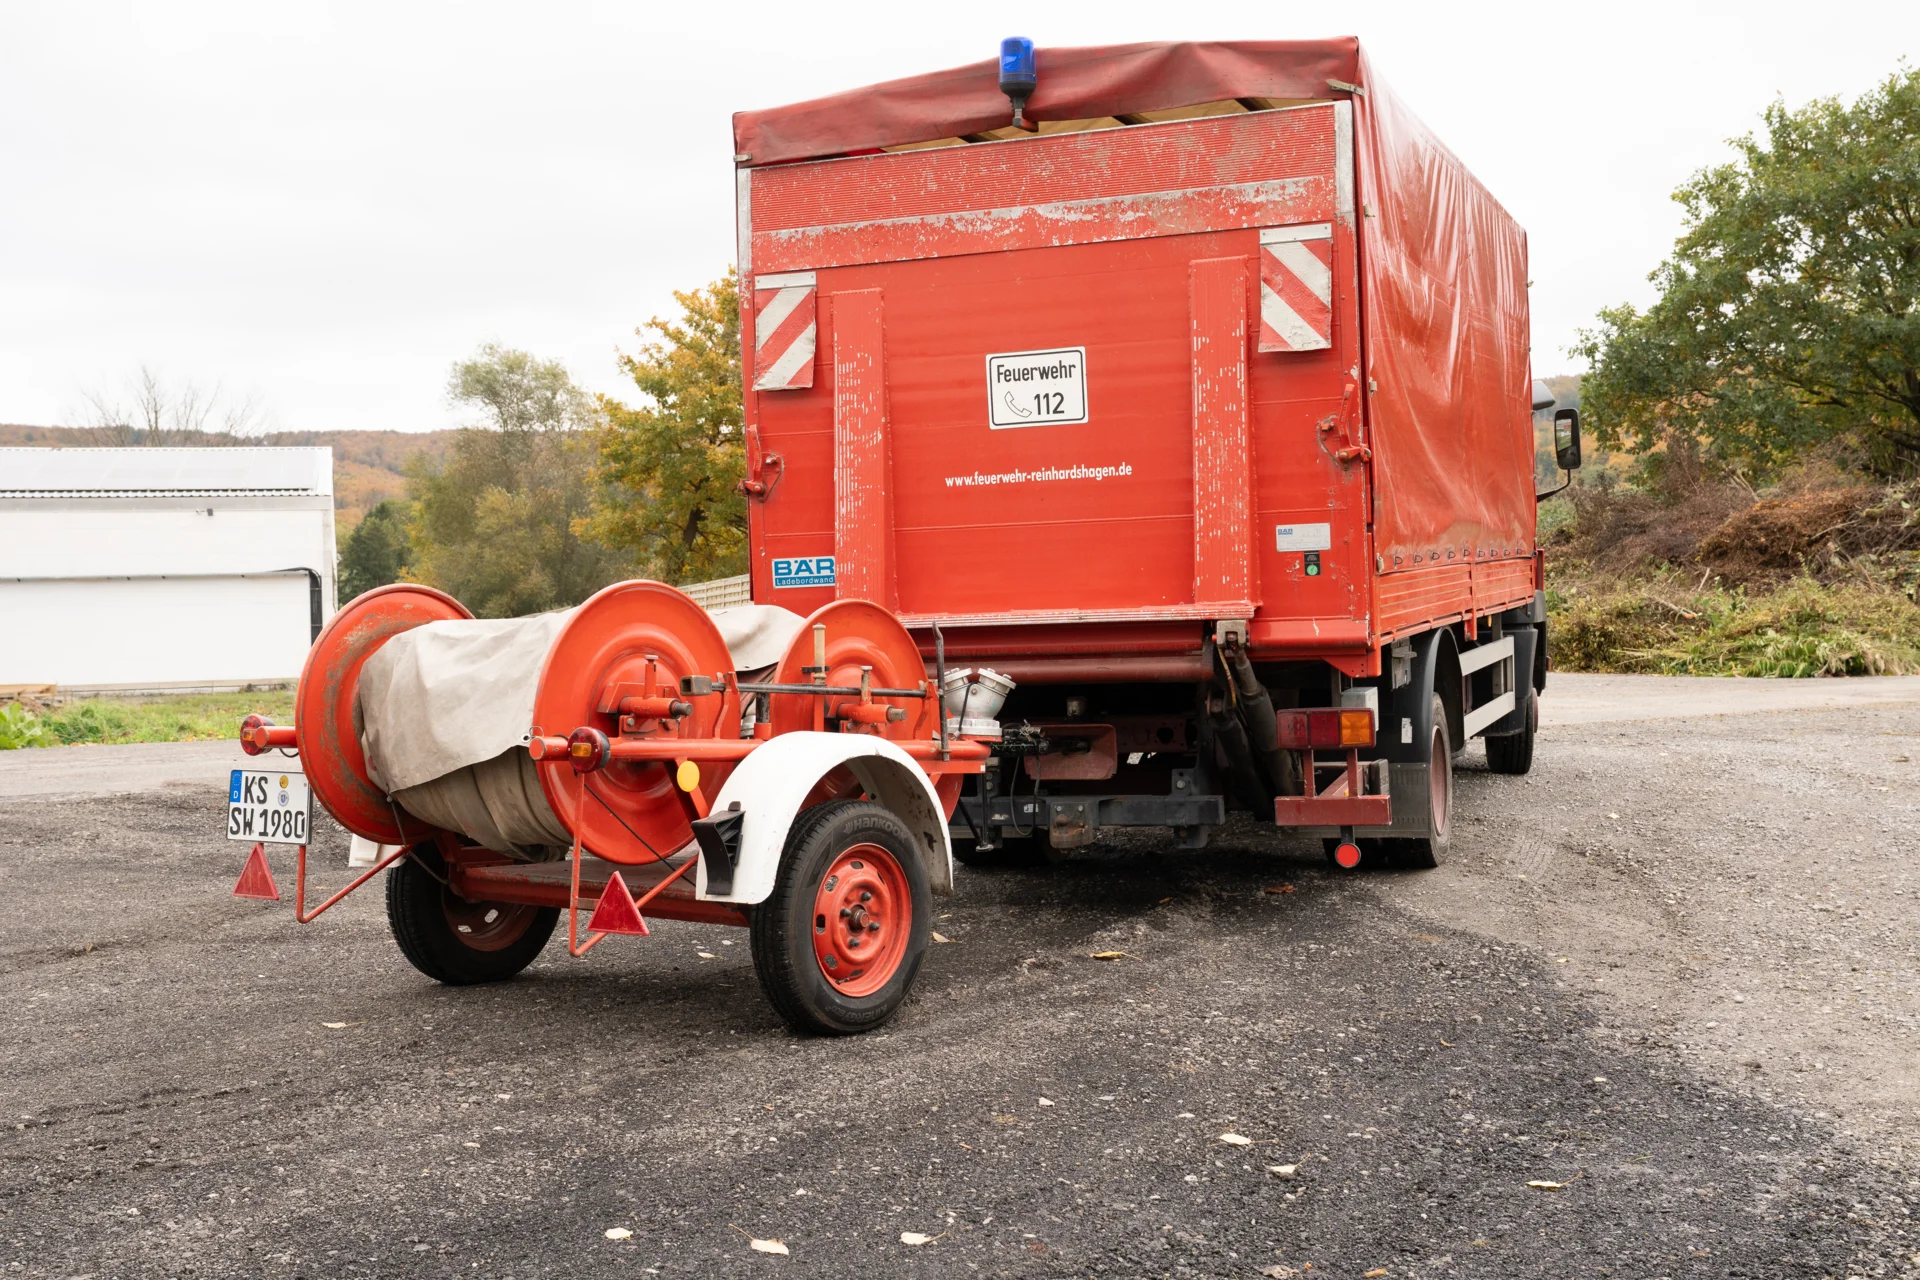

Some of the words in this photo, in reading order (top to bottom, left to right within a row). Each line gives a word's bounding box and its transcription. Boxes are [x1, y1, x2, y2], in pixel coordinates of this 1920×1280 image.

[997, 360, 1076, 384] Feuerwehr
[1034, 392, 1065, 415] 112
[945, 462, 1132, 487] www.feuerwehr-reinhardshagen.de
[774, 558, 835, 576] BÄR
[776, 577, 834, 586] Ladebordwand
[233, 790, 239, 799] D
[244, 776, 268, 804] KS
[230, 807, 254, 835] SW
[259, 809, 305, 838] 1980
